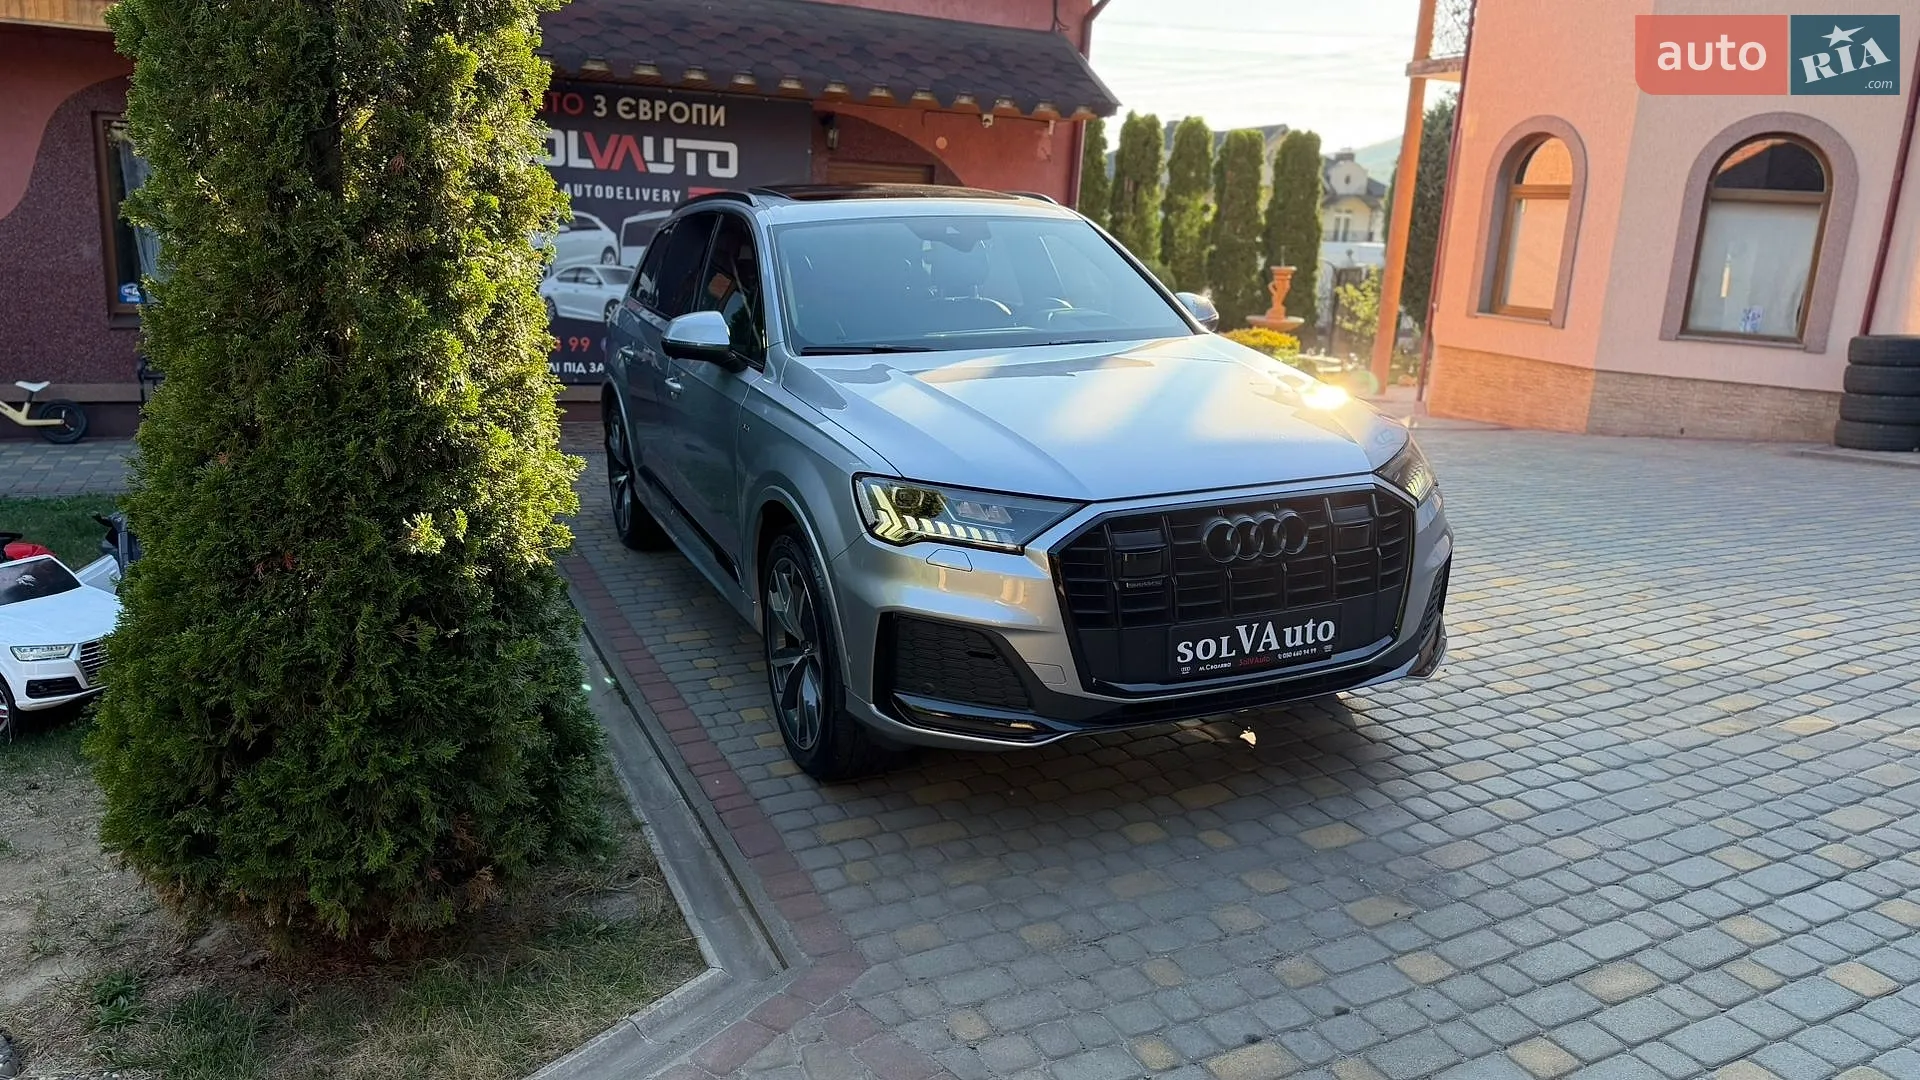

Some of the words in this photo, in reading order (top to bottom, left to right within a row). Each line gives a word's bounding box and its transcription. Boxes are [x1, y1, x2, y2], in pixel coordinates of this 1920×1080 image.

[616, 97, 726, 127] ЄВРОПИ
[542, 128, 738, 179] OLVAUTO
[560, 183, 681, 203] AUTODELIVERY
[568, 336, 590, 353] 99
[563, 361, 587, 374] ПІД
[589, 361, 604, 373] ЗА
